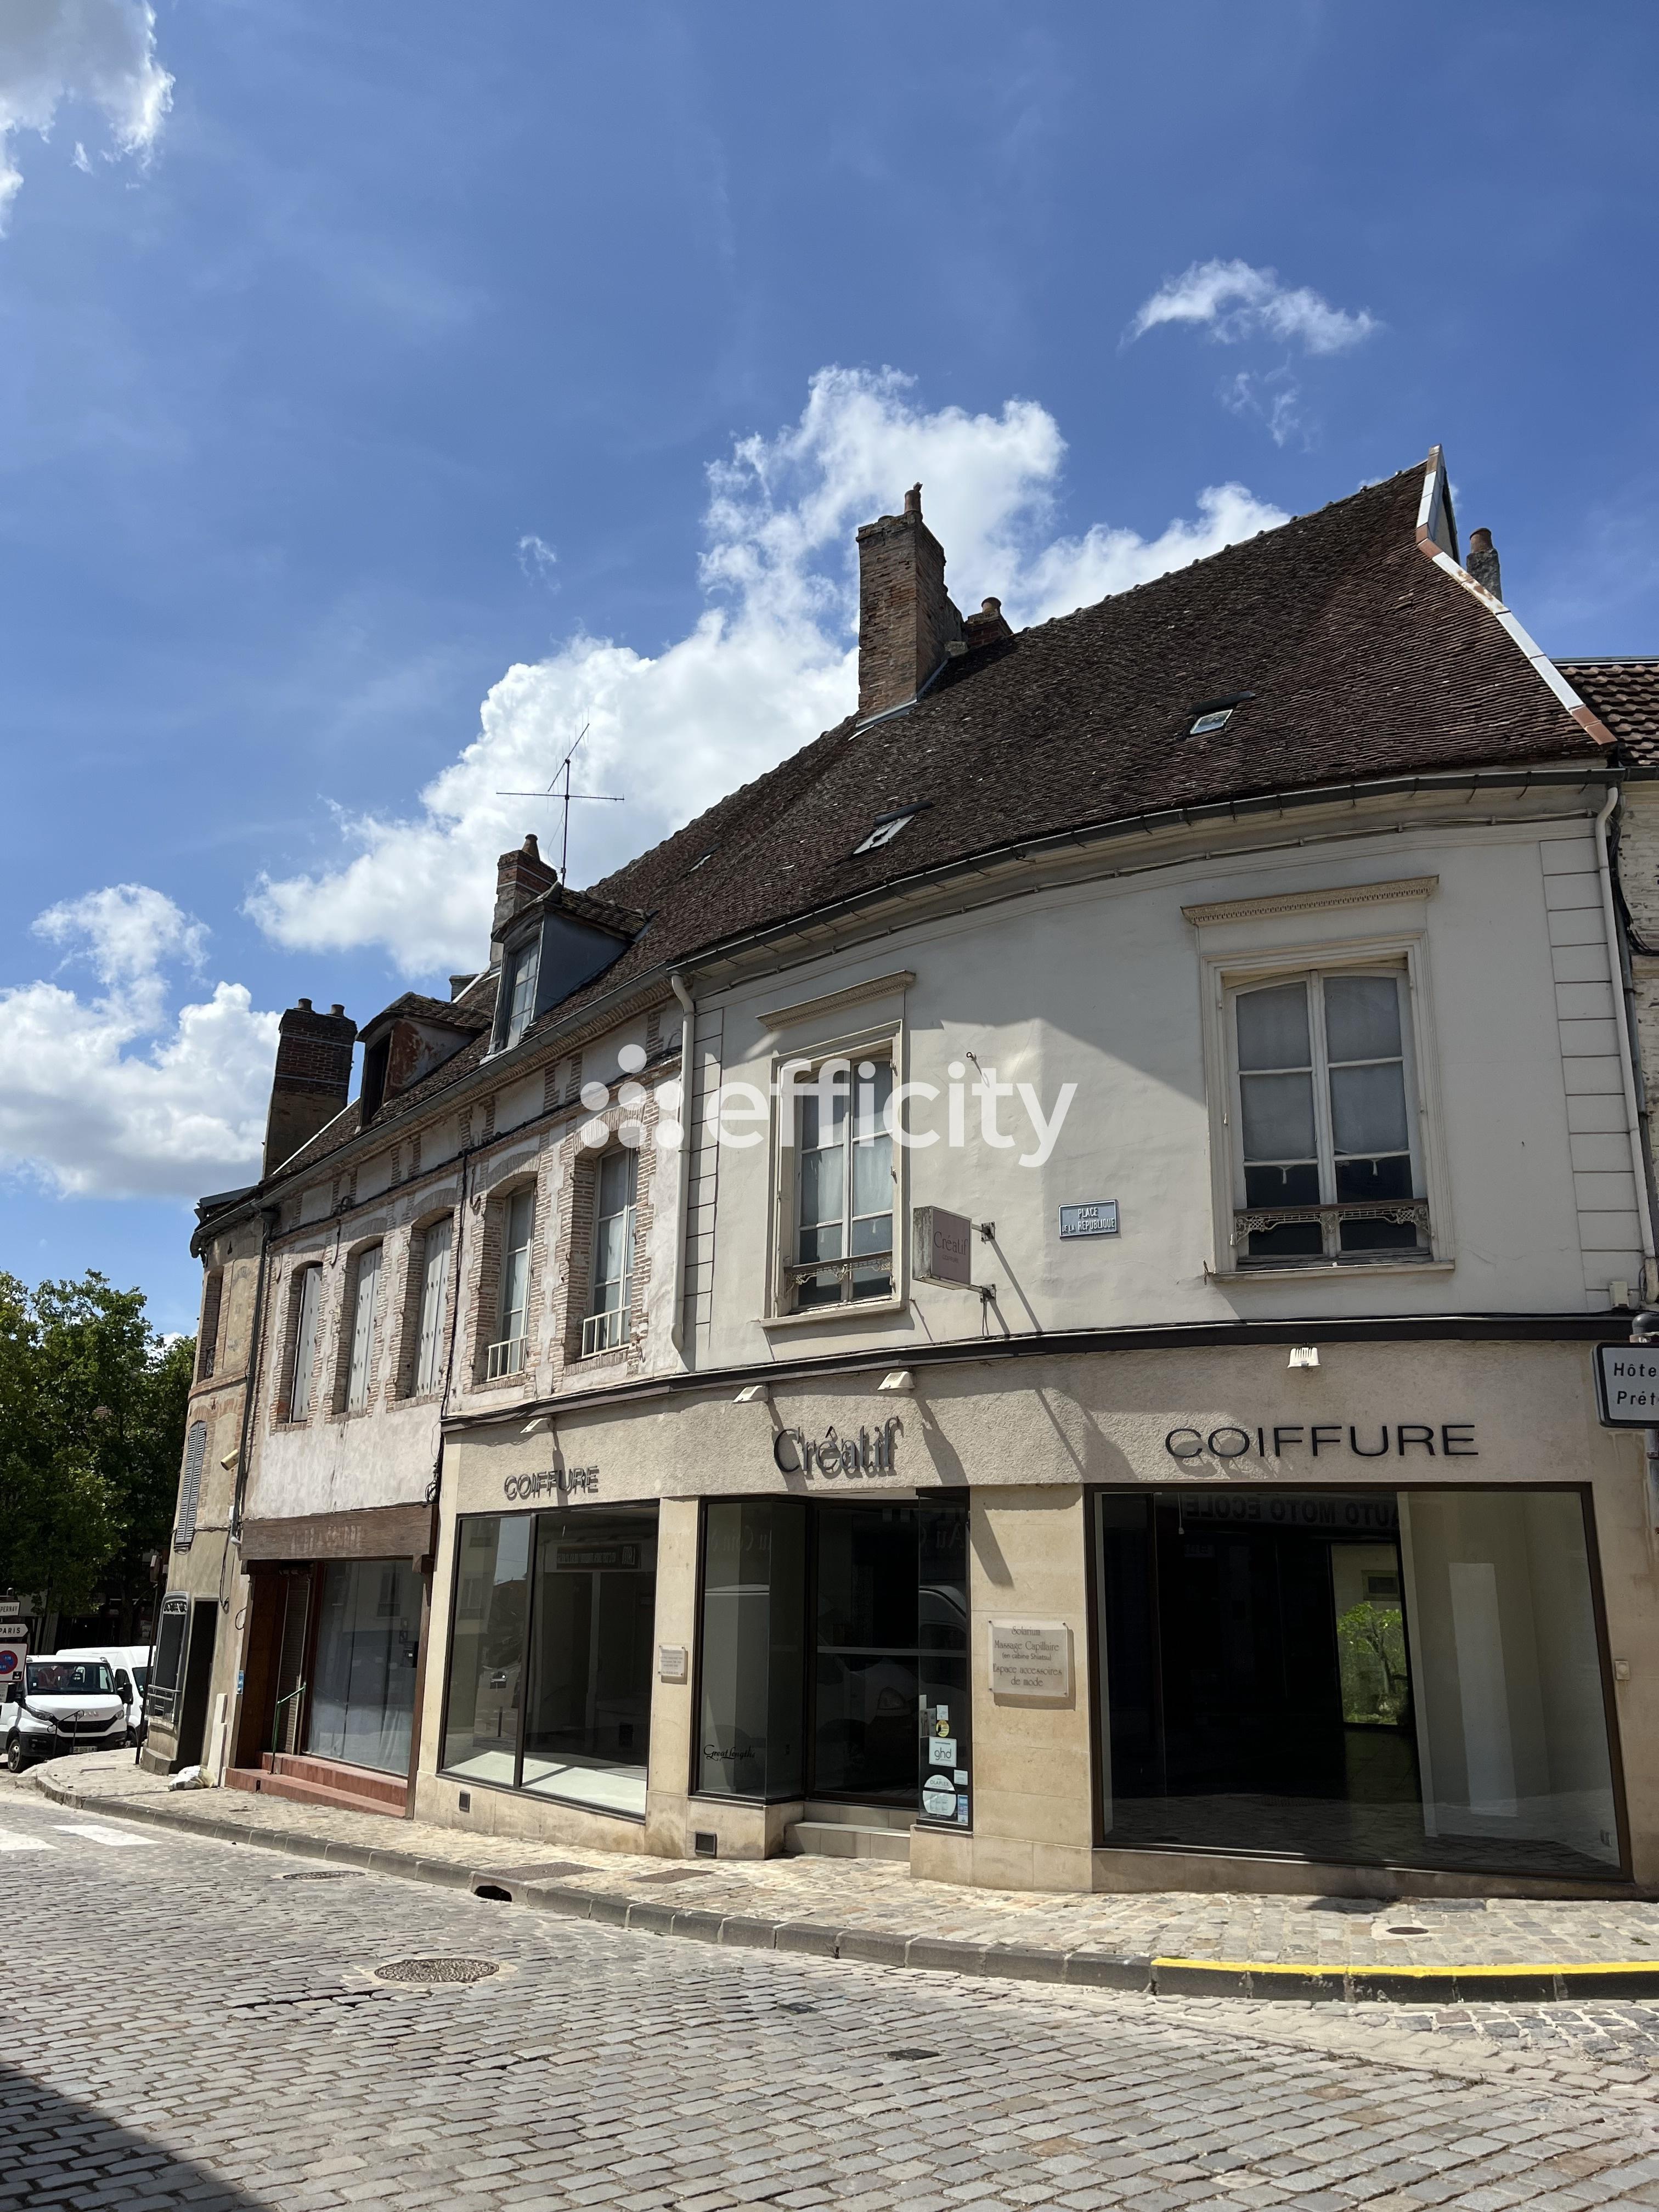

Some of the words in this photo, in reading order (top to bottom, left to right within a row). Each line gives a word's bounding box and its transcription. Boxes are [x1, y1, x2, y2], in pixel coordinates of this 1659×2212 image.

[1077, 1207, 1098, 1217] PLACE
[1077, 1218, 1115, 1231] REPUBLIQUE
[934, 1231, 968, 1256] Créatif
[1617, 1391, 1659, 1406] Prét
[1165, 1424, 1479, 1458] COIFFURE
[504, 1465, 599, 1497] COIFFURE
[1012, 1626, 1041, 1635] Solarium
[995, 1640, 1023, 1653] Massage
[1025, 1641, 1059, 1653] Capillaire
[992, 1663, 1017, 1675] Espace
[1020, 1667, 1063, 1675] accessoires
[1011, 1676, 1020, 1685] de
[1023, 1677, 1043, 1686] mode
[934, 1747, 952, 1760] ghd
